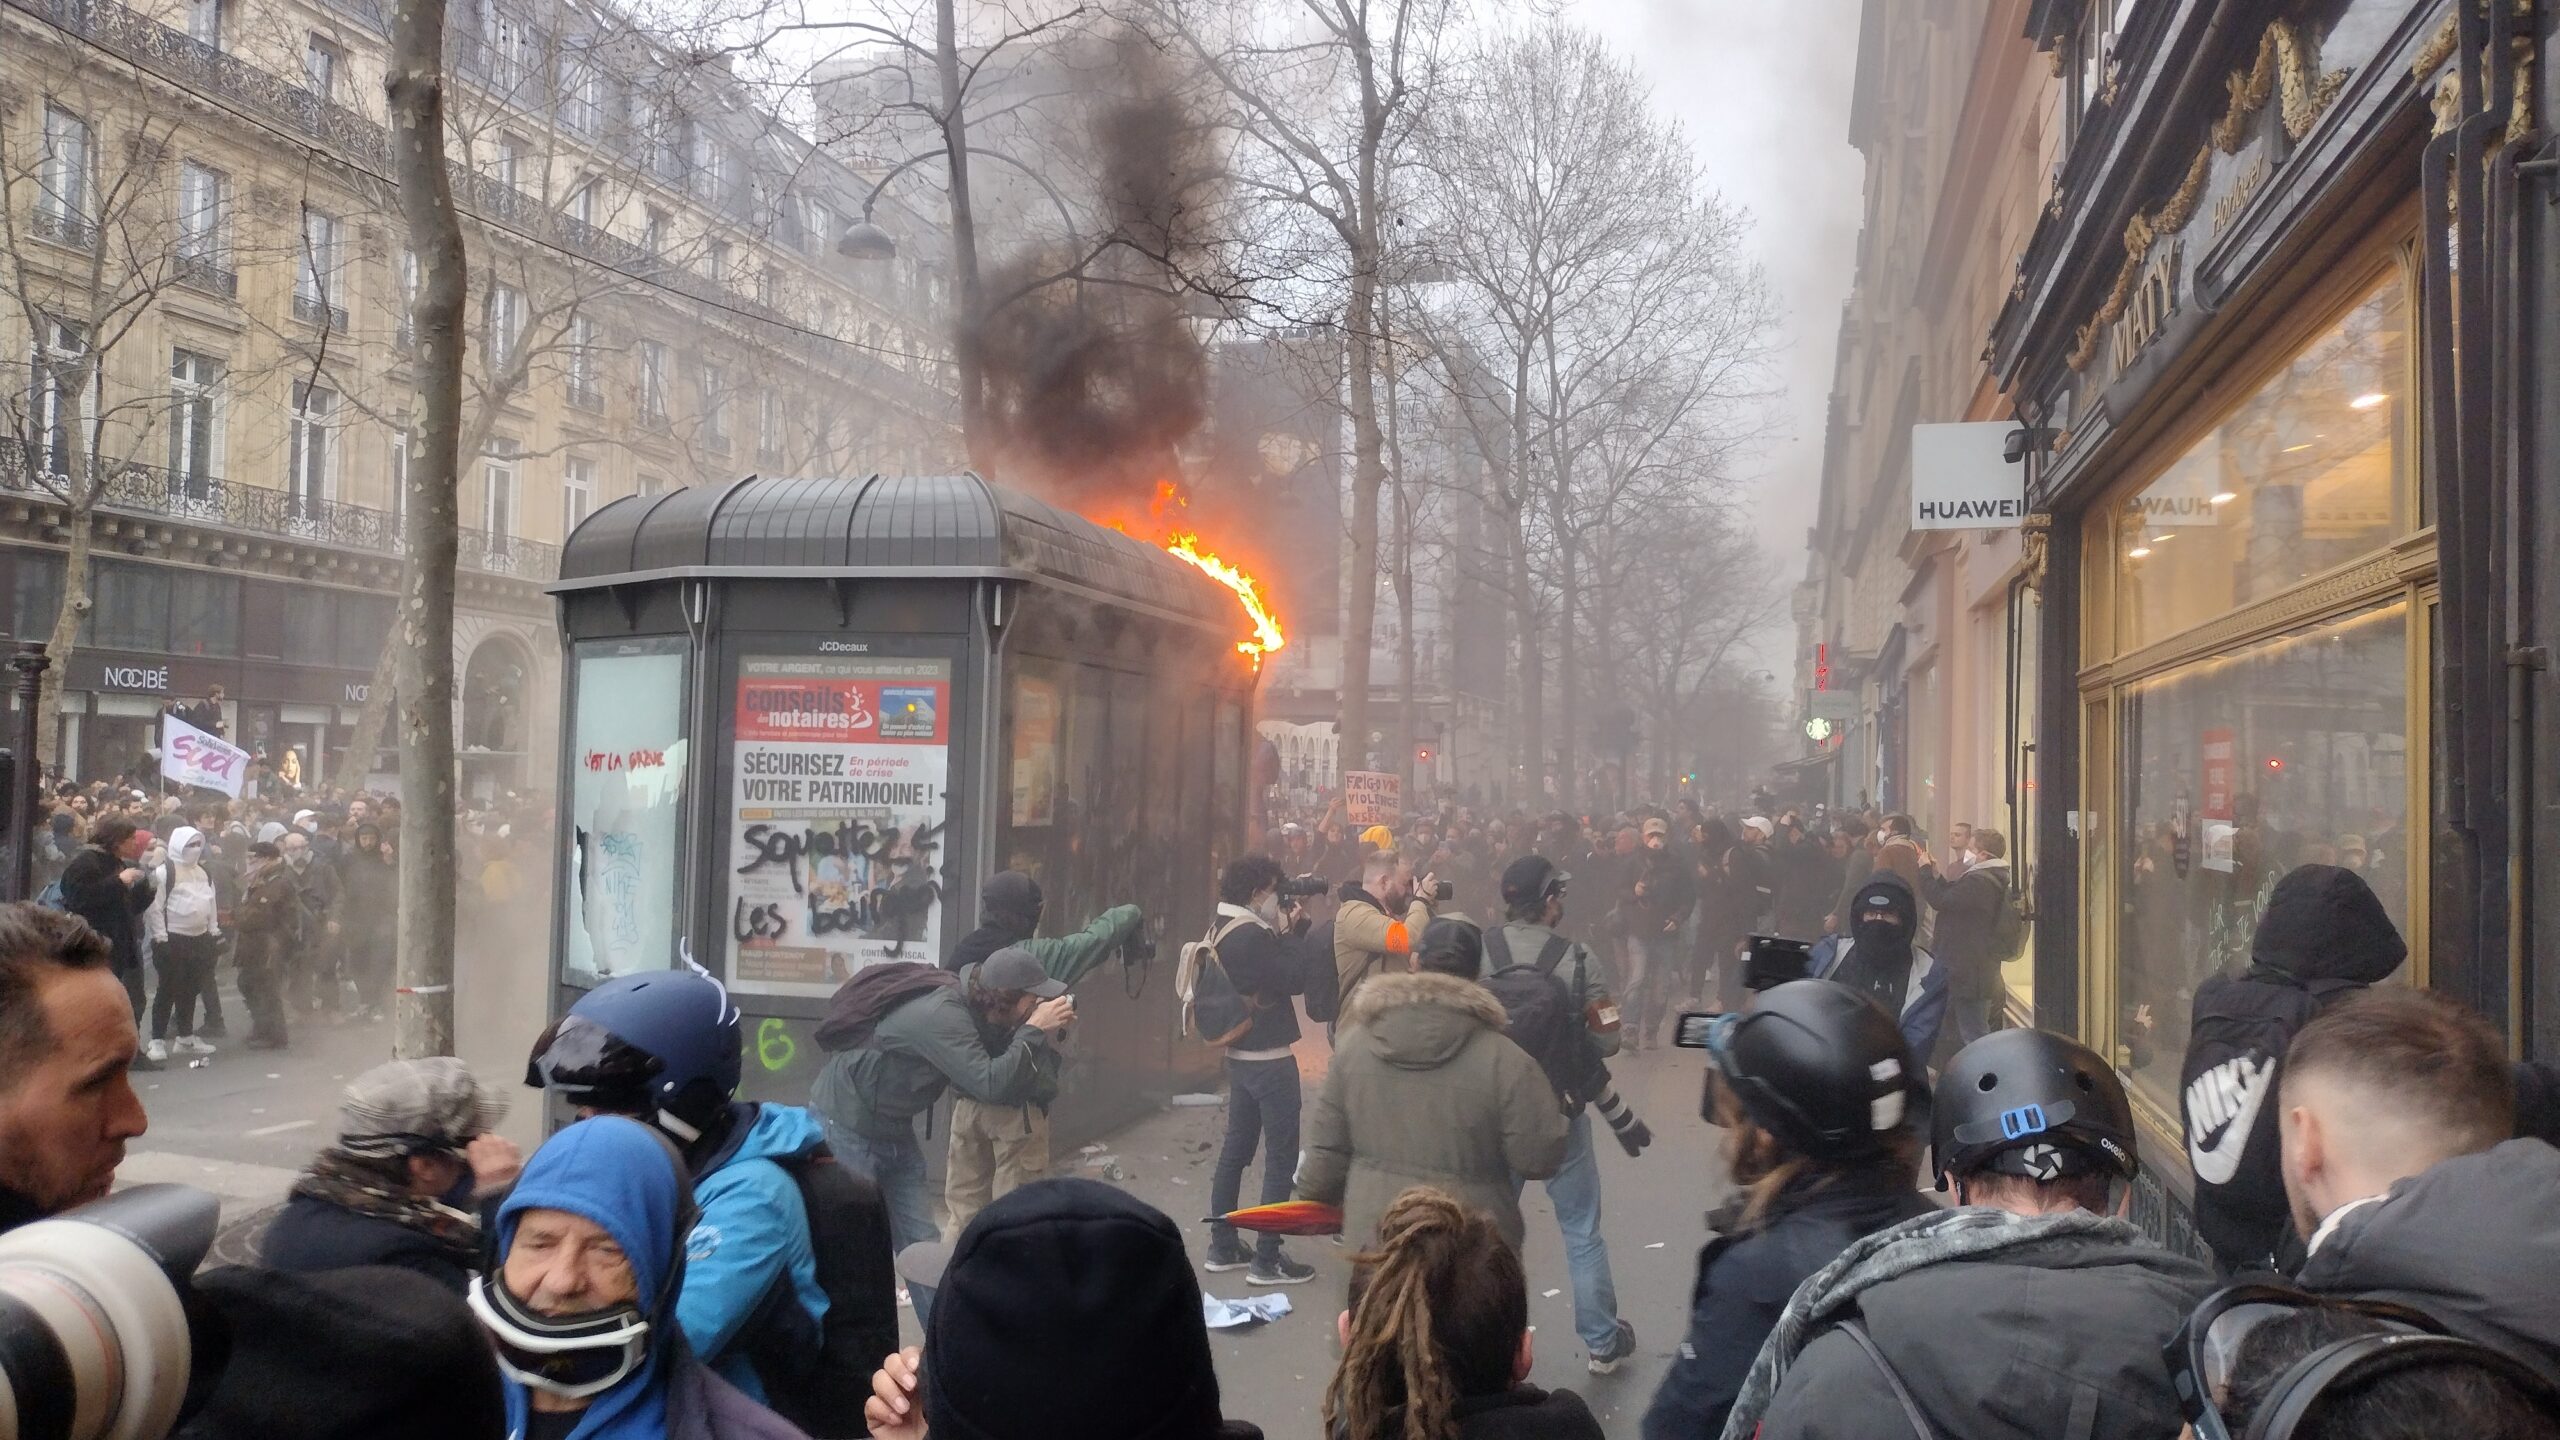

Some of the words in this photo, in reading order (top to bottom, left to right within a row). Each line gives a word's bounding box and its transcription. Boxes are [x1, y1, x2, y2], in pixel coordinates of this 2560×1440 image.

[2212, 152, 2264, 238] Horloger
[2112, 240, 2176, 384] MATY
[1919, 500, 2022, 519] HUAWEI
[819, 641, 868, 652] JCDecaux
[105, 666, 168, 690] NOCIBÉ
[746, 662, 780, 674] VOTRE
[781, 663, 824, 675] ARGENT,
[837, 665, 850, 676] qui
[852, 666, 873, 674] vous
[904, 666, 915, 675] en
[916, 665, 939, 675] 2023
[746, 686, 844, 712] conseils
[769, 708, 850, 728] notaires
[608, 752, 622, 771] LA
[744, 747, 844, 776] SÉCURISEZ
[850, 756, 863, 765] En
[867, 757, 910, 769] période
[850, 768, 863, 777] de
[866, 769, 894, 778] crise
[743, 779, 802, 802] VOTRE
[809, 781, 924, 806] PATRIMOINE
[927, 783, 933, 806] !
[1348, 792, 1399, 809] VIOLENCE
[2100, 1137, 2127, 1162] oxelo
